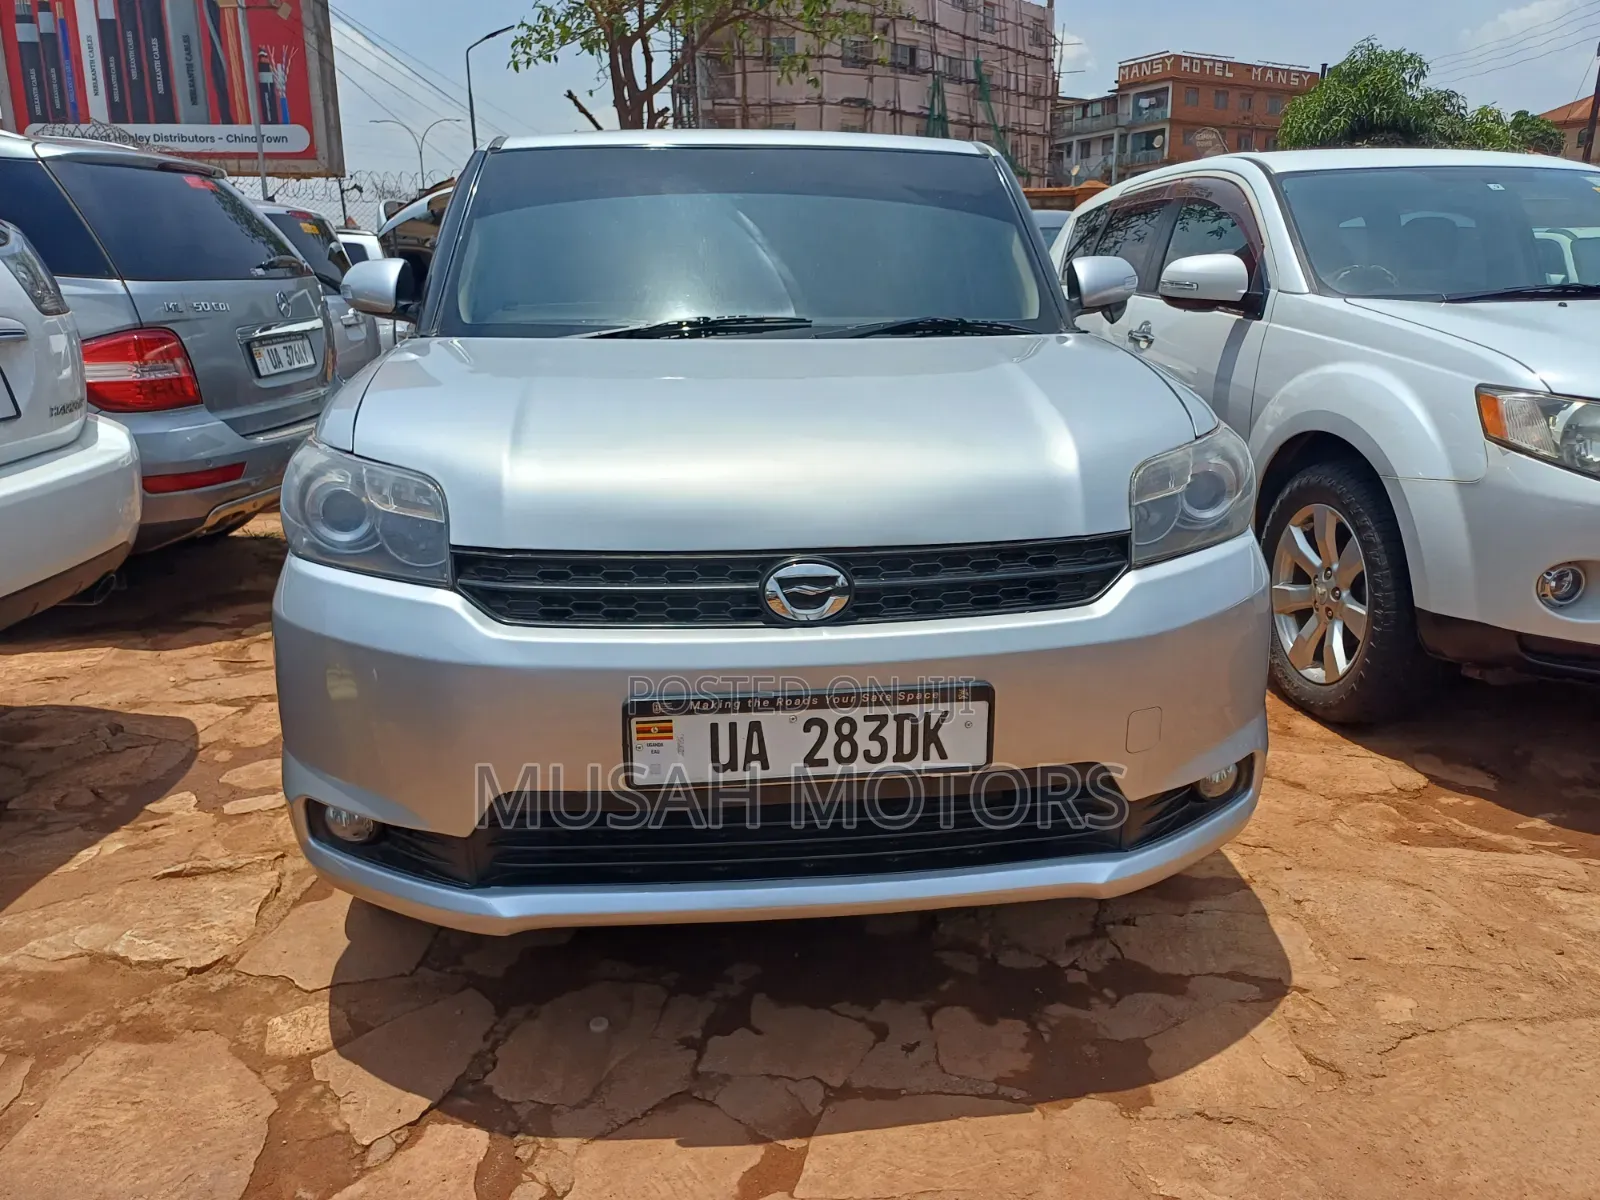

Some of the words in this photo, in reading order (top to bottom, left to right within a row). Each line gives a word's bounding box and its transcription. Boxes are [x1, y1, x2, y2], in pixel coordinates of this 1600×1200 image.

[86, 35, 94, 58] CABLES
[151, 37, 160, 59] CABLES
[89, 59, 99, 96] NEELKANTH
[154, 60, 164, 95] NEELKANTH
[1119, 56, 1175, 82] MANSY
[1181, 57, 1234, 78] HOTEL
[1252, 65, 1311, 86] MANSY
[153, 133, 215, 144] Distributors
[226, 133, 258, 144] China
[260, 134, 288, 144] Town
[690, 700, 741, 711] Making
[747, 699, 769, 707] the
[776, 697, 818, 707] Roads
[825, 692, 856, 704] Your
[862, 691, 892, 703] Safe
[898, 690, 939, 701] Space
[709, 720, 770, 774] UA
[802, 710, 949, 768] 283DK
